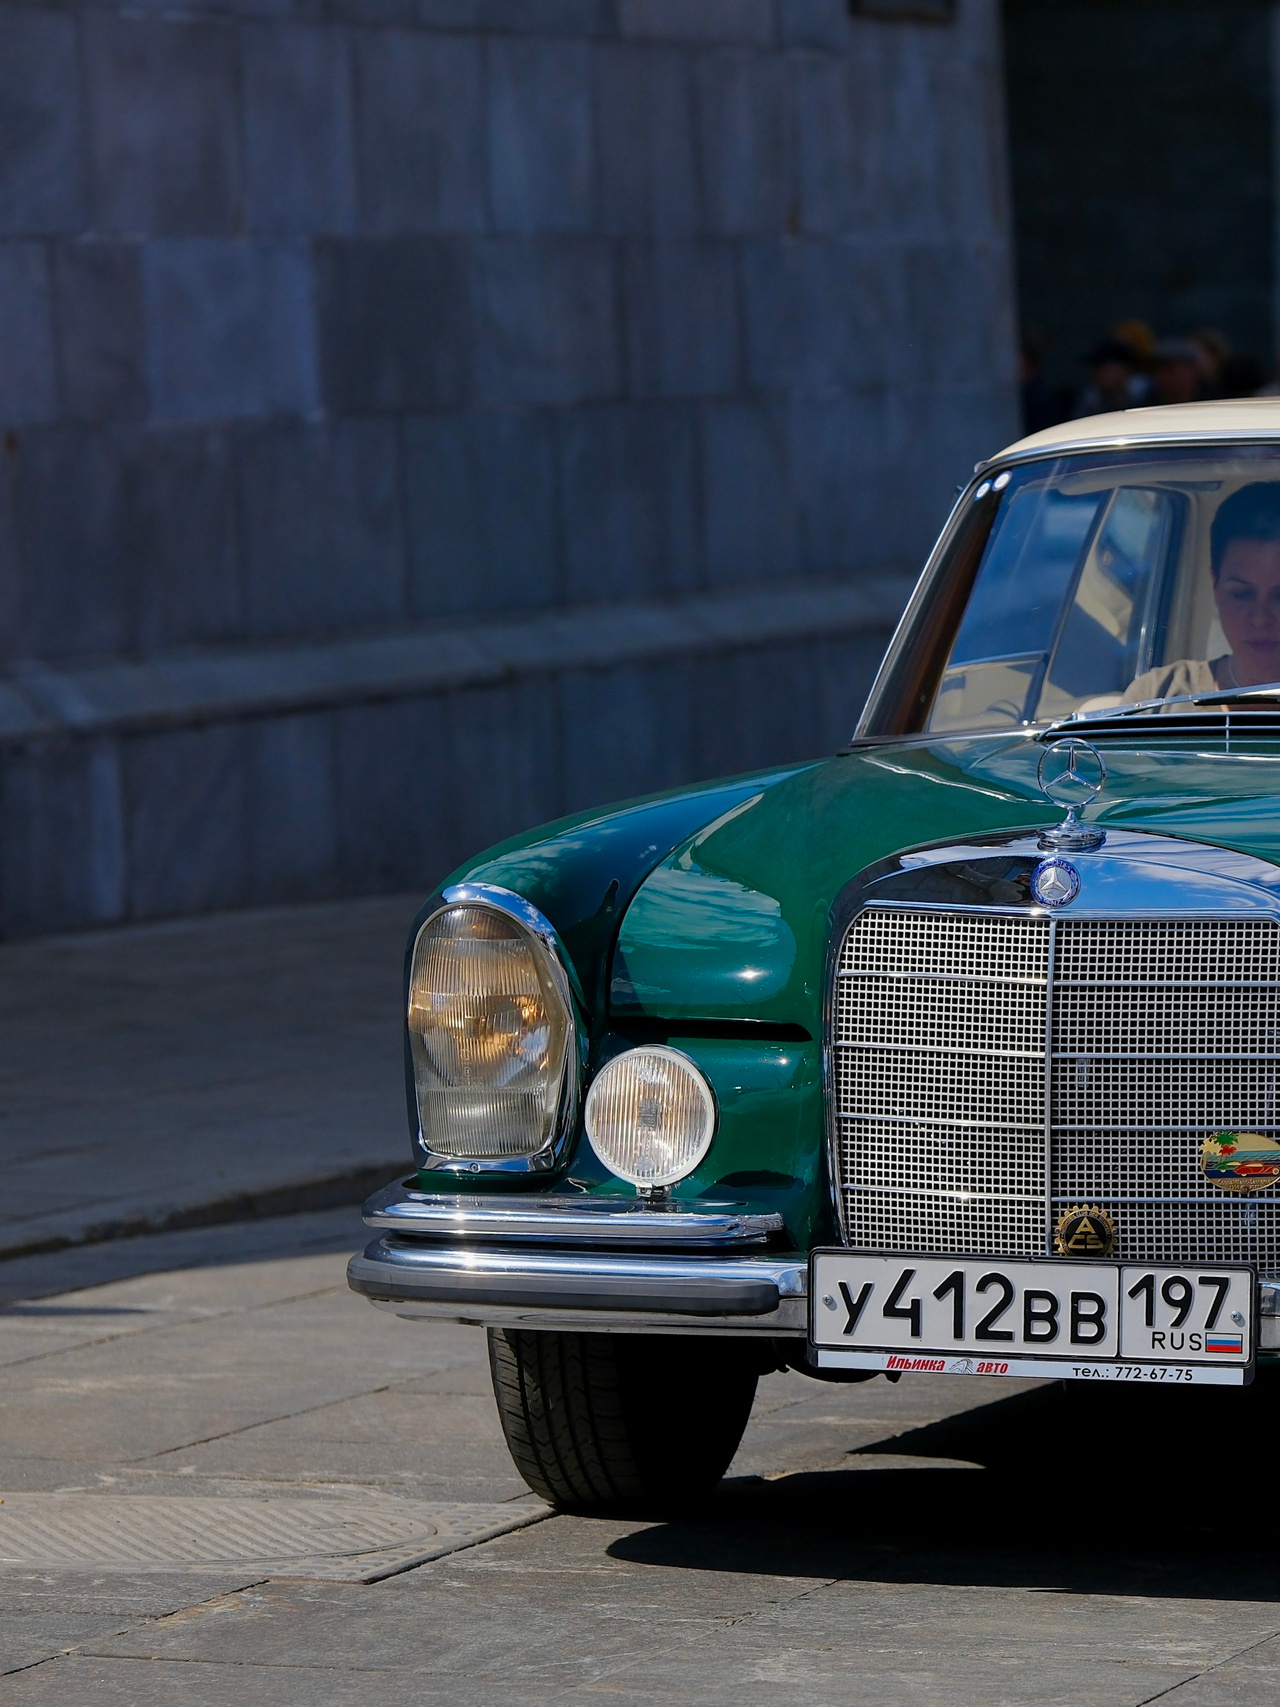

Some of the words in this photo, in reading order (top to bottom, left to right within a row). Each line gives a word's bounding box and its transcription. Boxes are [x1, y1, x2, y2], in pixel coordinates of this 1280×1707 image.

[1127, 1273, 1230, 1330] 197
[1151, 1331, 1203, 1351] RUS
[886, 1355, 946, 1371] Ильинка
[976, 1362, 1009, 1374] авто
[1072, 1366, 1110, 1378] тел.:
[1115, 1366, 1194, 1381] 772-67-75
